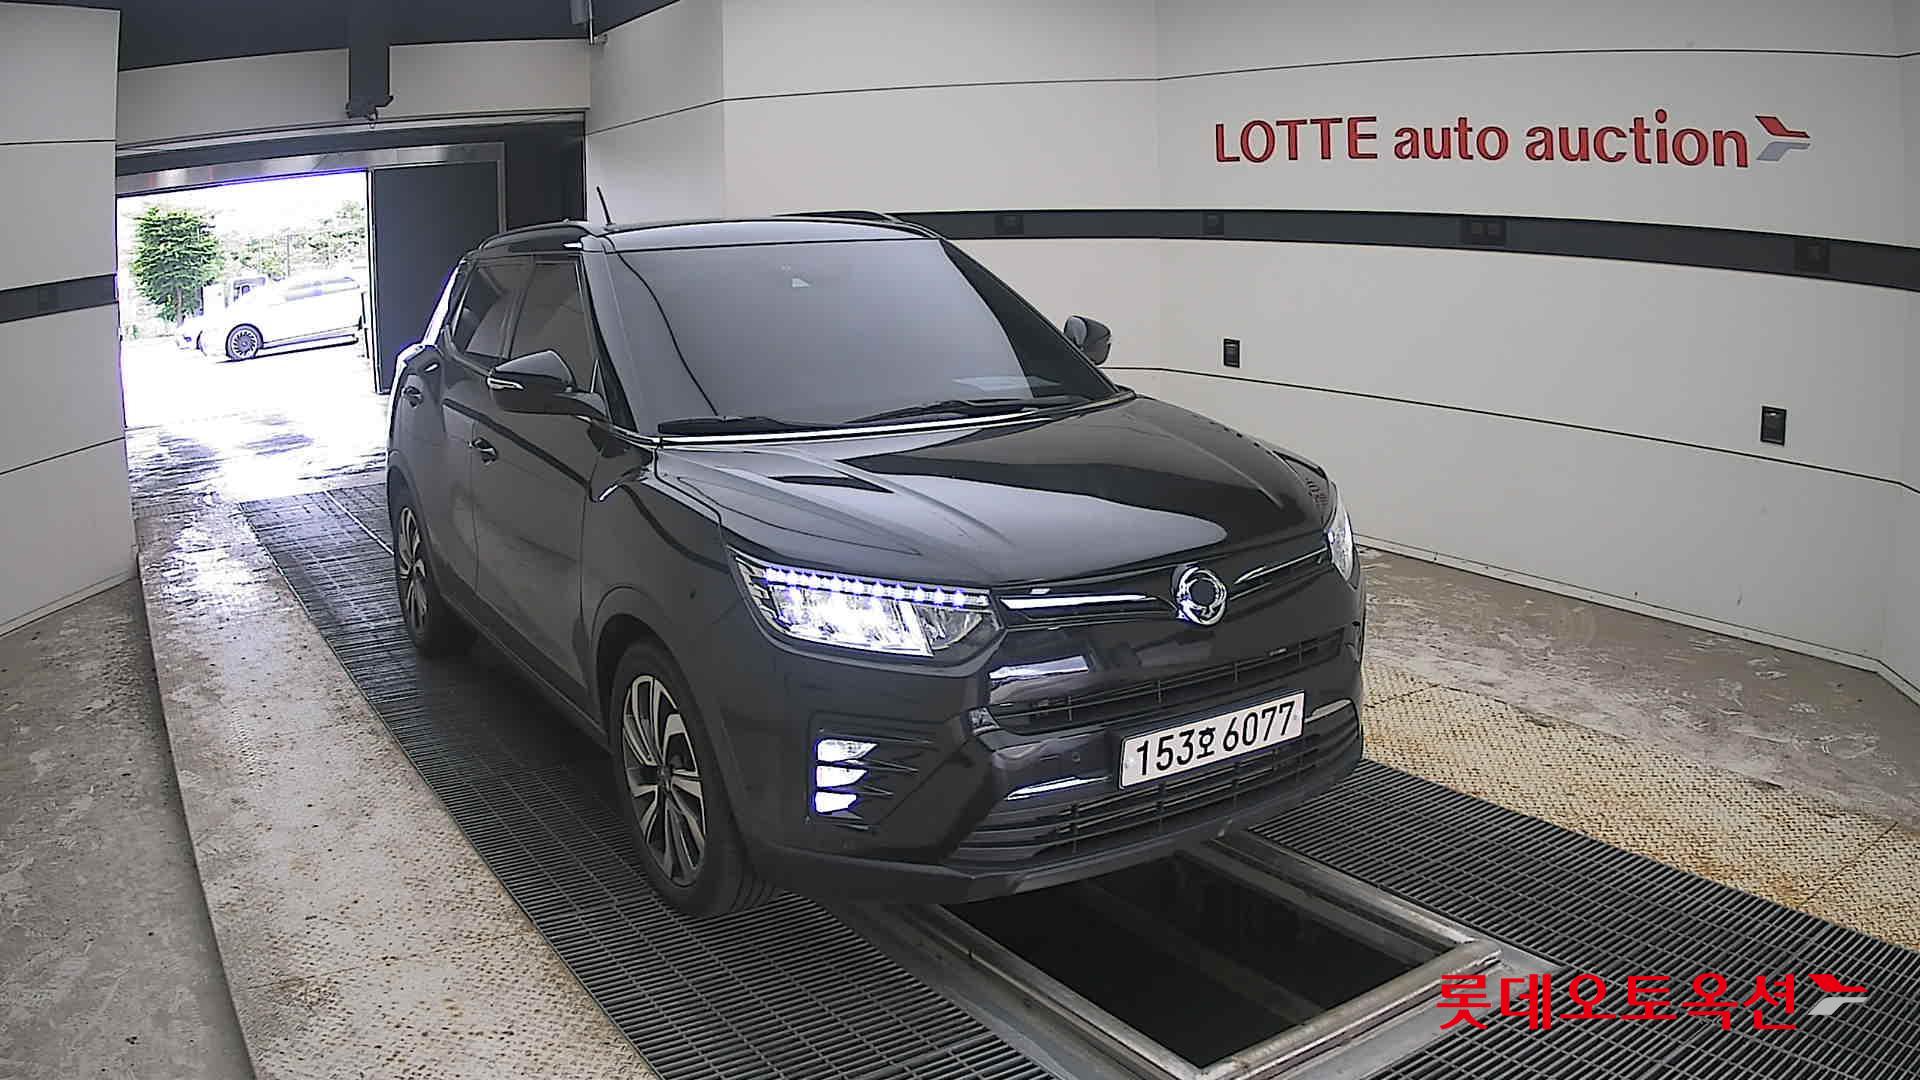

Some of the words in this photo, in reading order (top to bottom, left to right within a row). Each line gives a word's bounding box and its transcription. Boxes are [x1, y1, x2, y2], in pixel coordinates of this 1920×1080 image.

[1215, 116, 1377, 162] LOTTE
[1393, 117, 1510, 161] auto
[1524, 109, 1751, 168] auction
